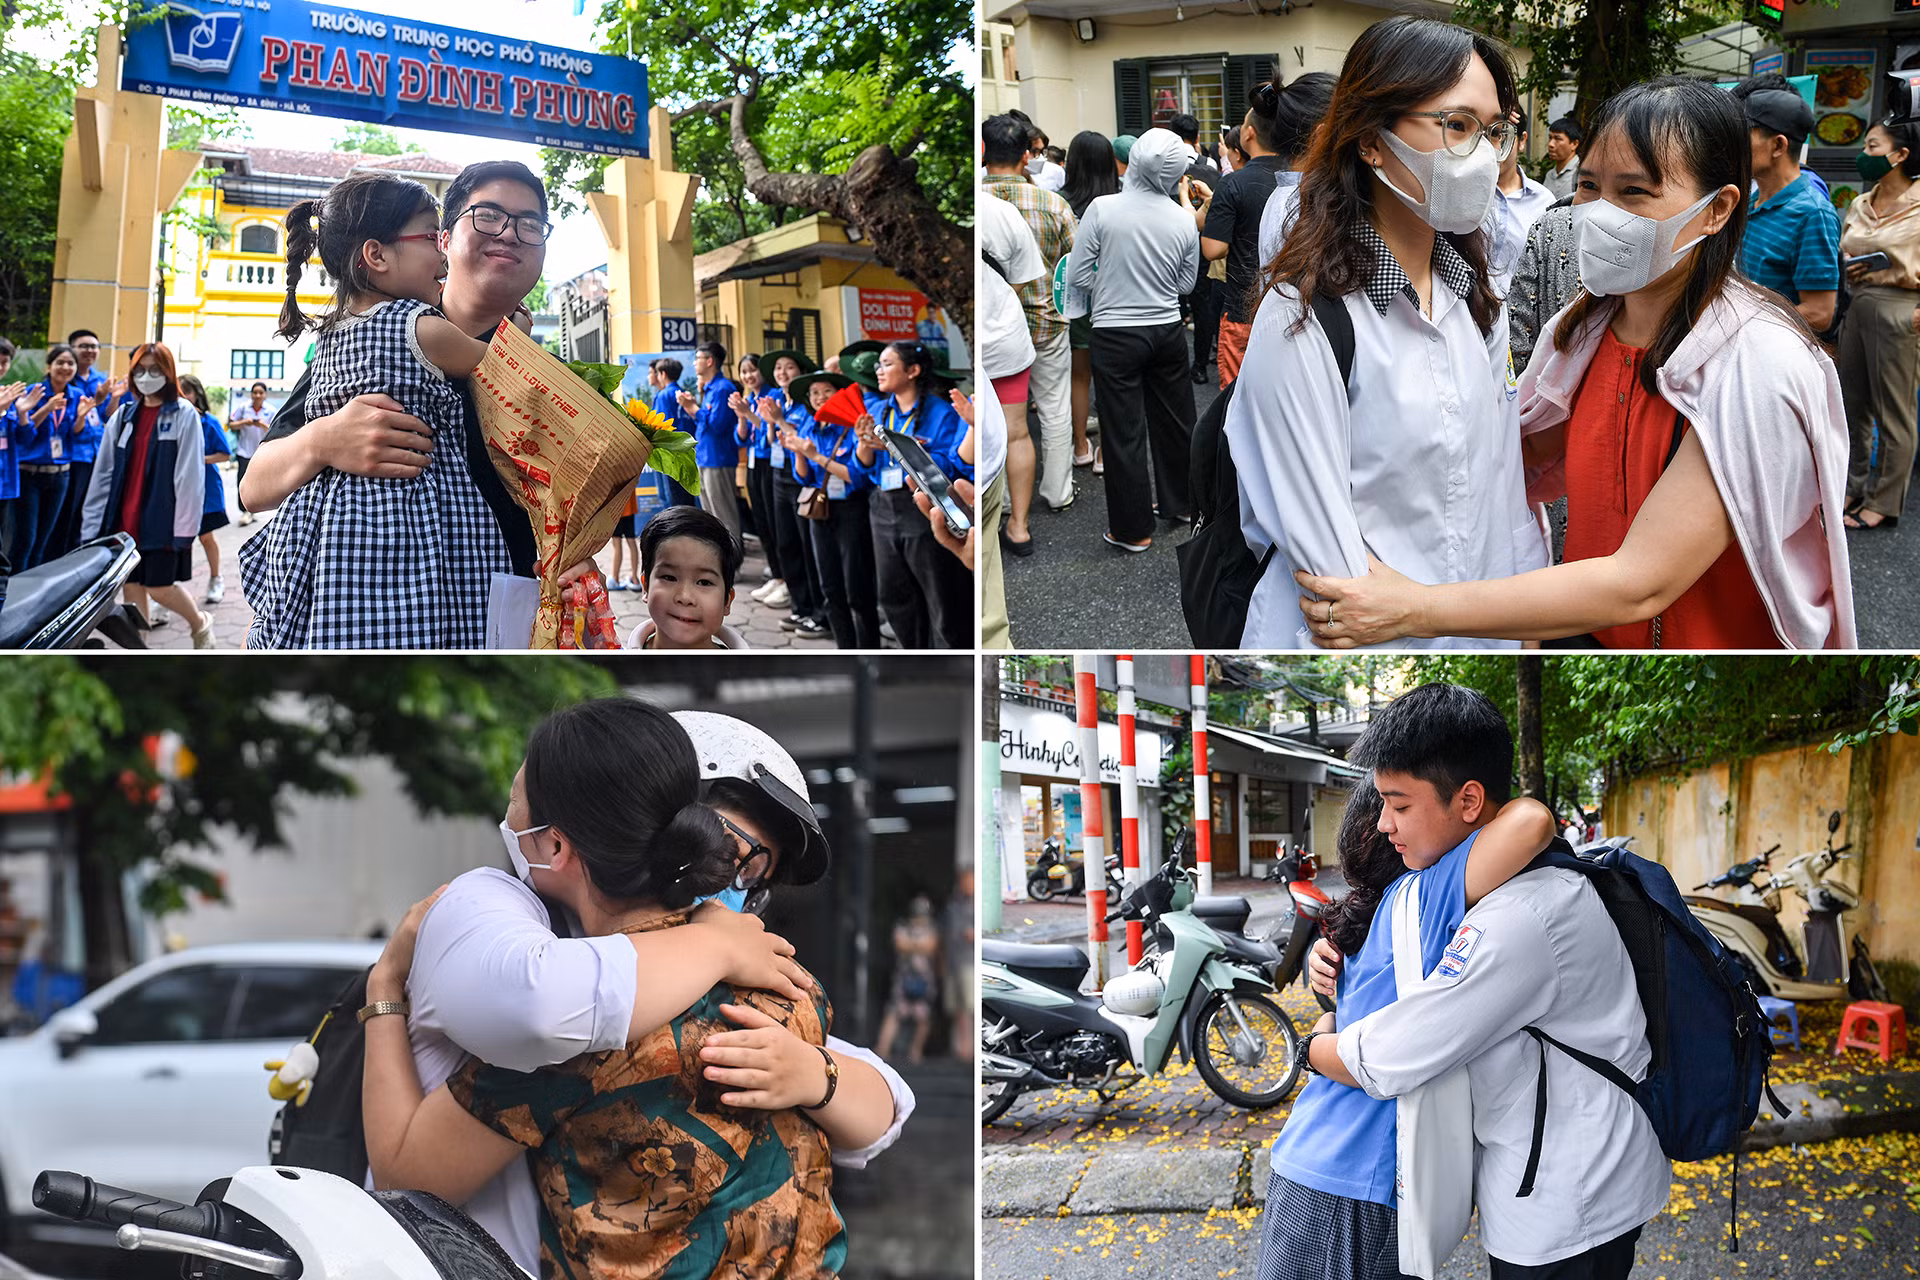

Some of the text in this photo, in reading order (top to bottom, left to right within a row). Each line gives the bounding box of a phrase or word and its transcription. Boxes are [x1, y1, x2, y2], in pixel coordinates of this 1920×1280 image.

[310, 10, 593, 75] TRƯỜNG TRUNG HỌC PHỔ THÔNG
[168, 86, 190, 98] PHAN
[260, 36, 637, 134] PHAN ĐÌNH PHÙNG
[663, 319, 695, 342] 30
[491, 341, 508, 359] HOW
[506, 356, 520, 370] DO
[523, 372, 551, 395] LOVE
[550, 393, 579, 419] THEE
